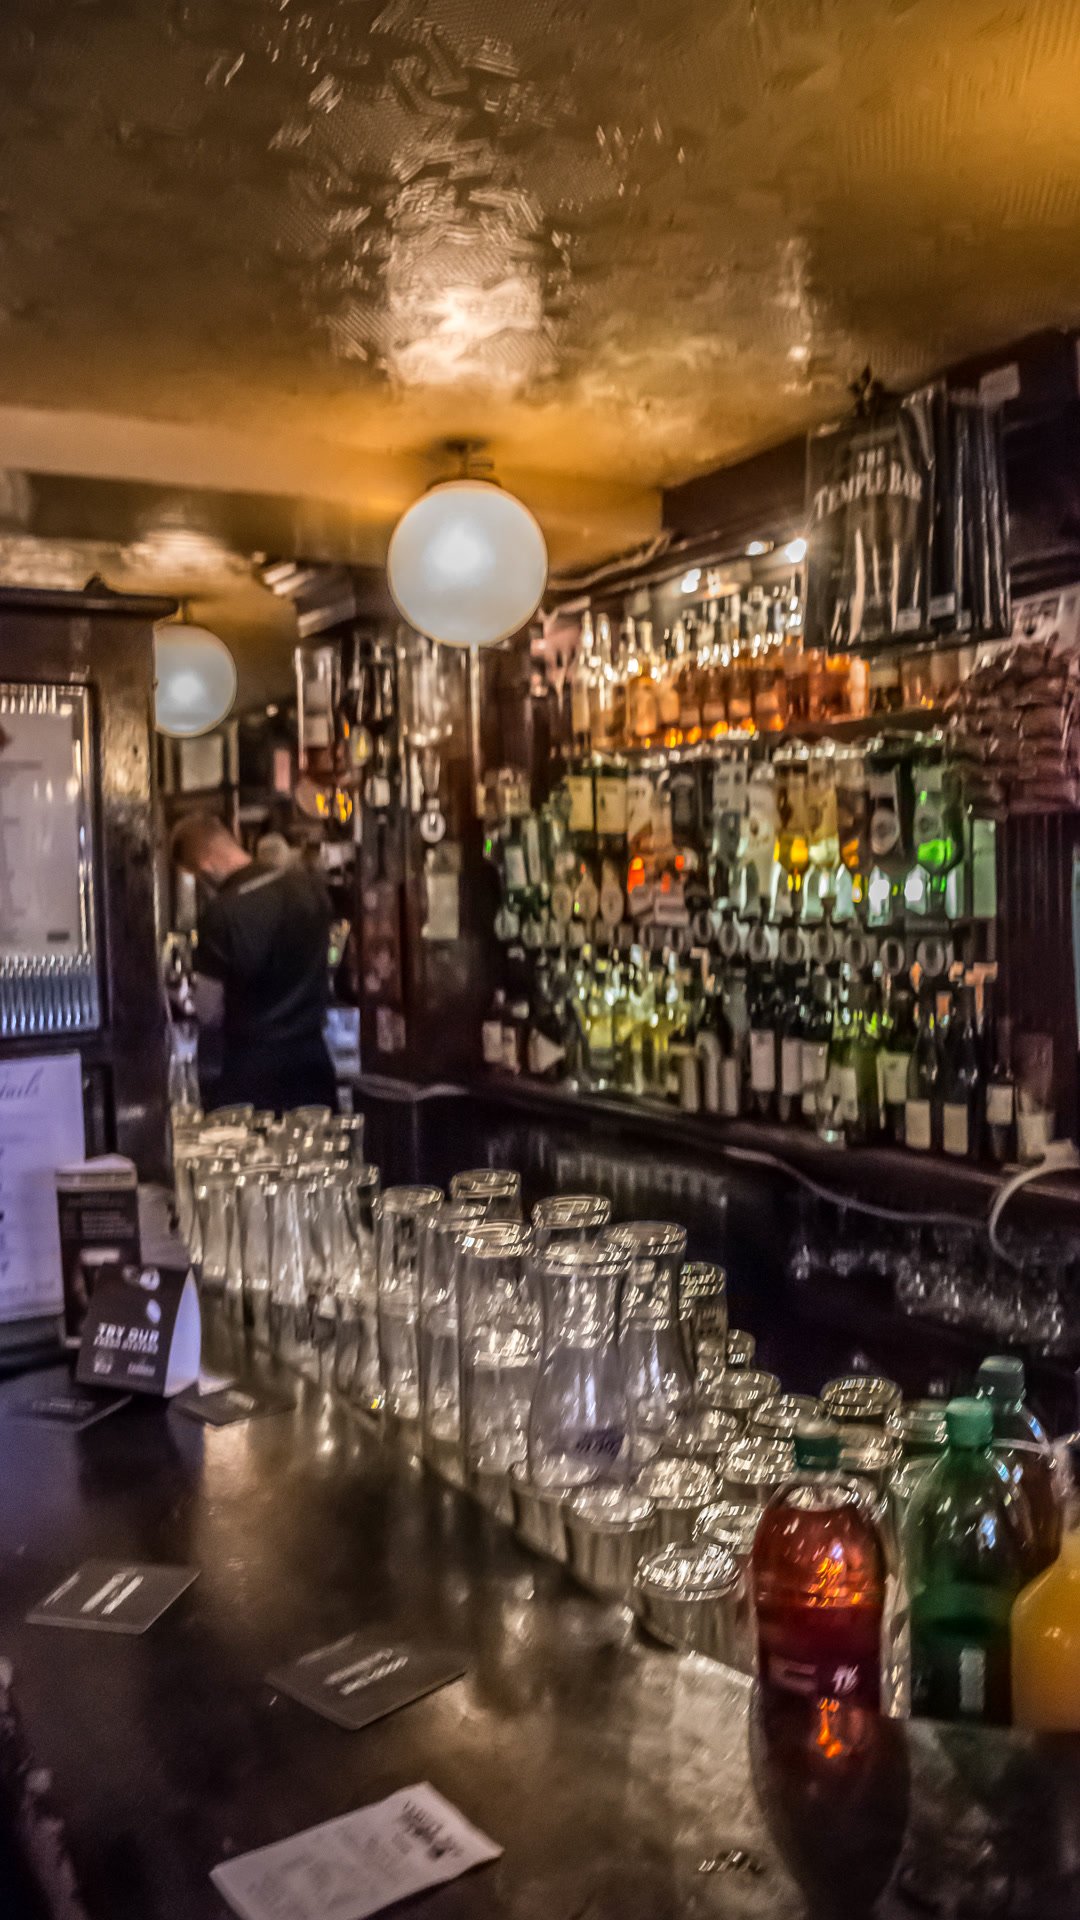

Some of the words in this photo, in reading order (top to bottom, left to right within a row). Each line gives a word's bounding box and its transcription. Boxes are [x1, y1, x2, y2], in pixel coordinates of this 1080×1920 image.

[814, 468, 886, 519] TEMPLE
[98, 1322, 125, 1341] TRY
[128, 1326, 160, 1345] OUR
